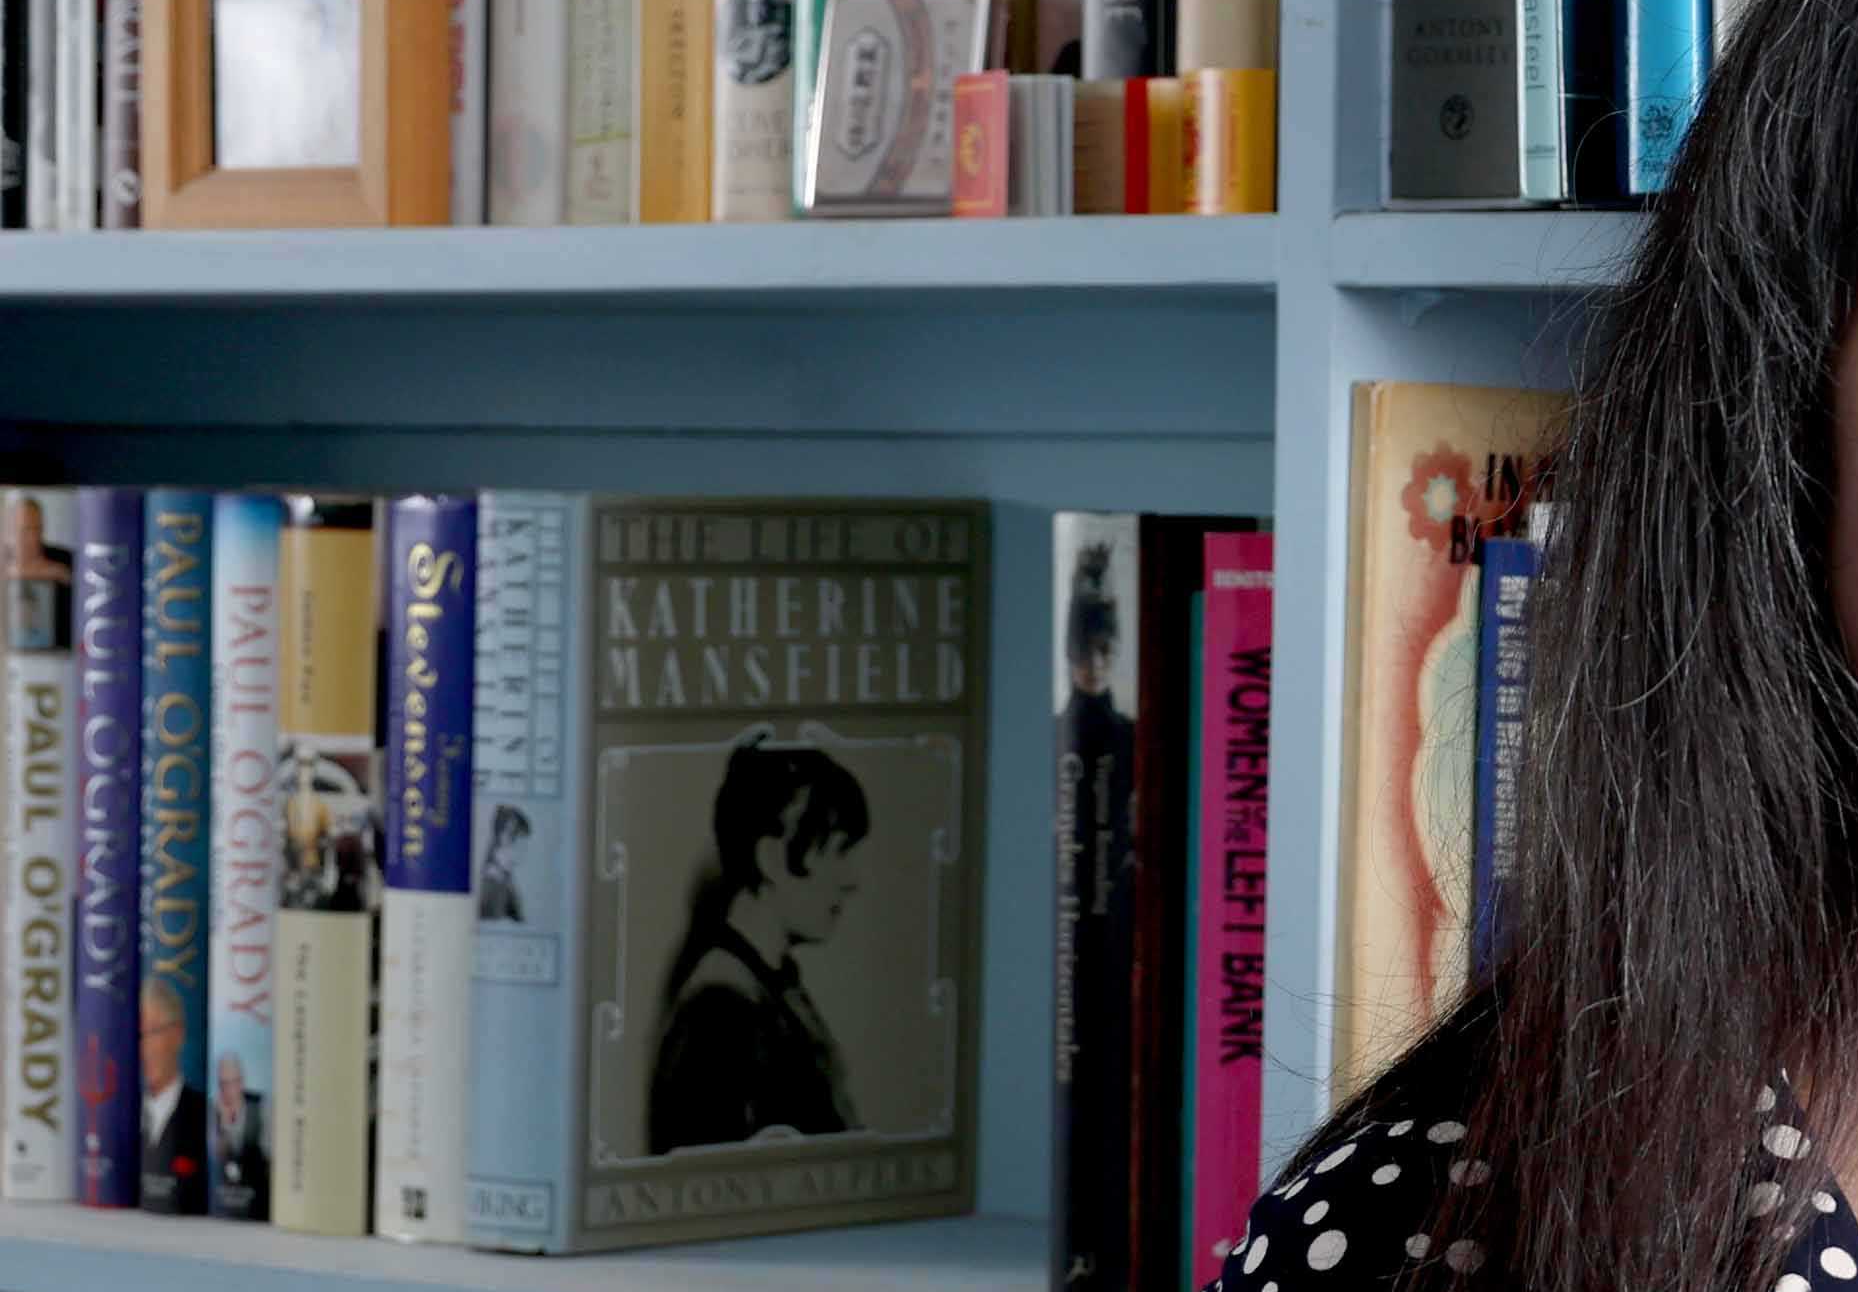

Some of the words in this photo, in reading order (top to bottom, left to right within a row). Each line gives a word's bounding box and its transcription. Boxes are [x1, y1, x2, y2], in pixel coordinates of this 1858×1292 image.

[606, 575, 965, 639] KATHERINE
[600, 644, 965, 708] MANSFIELD
[23, 681, 63, 833] PAUL
